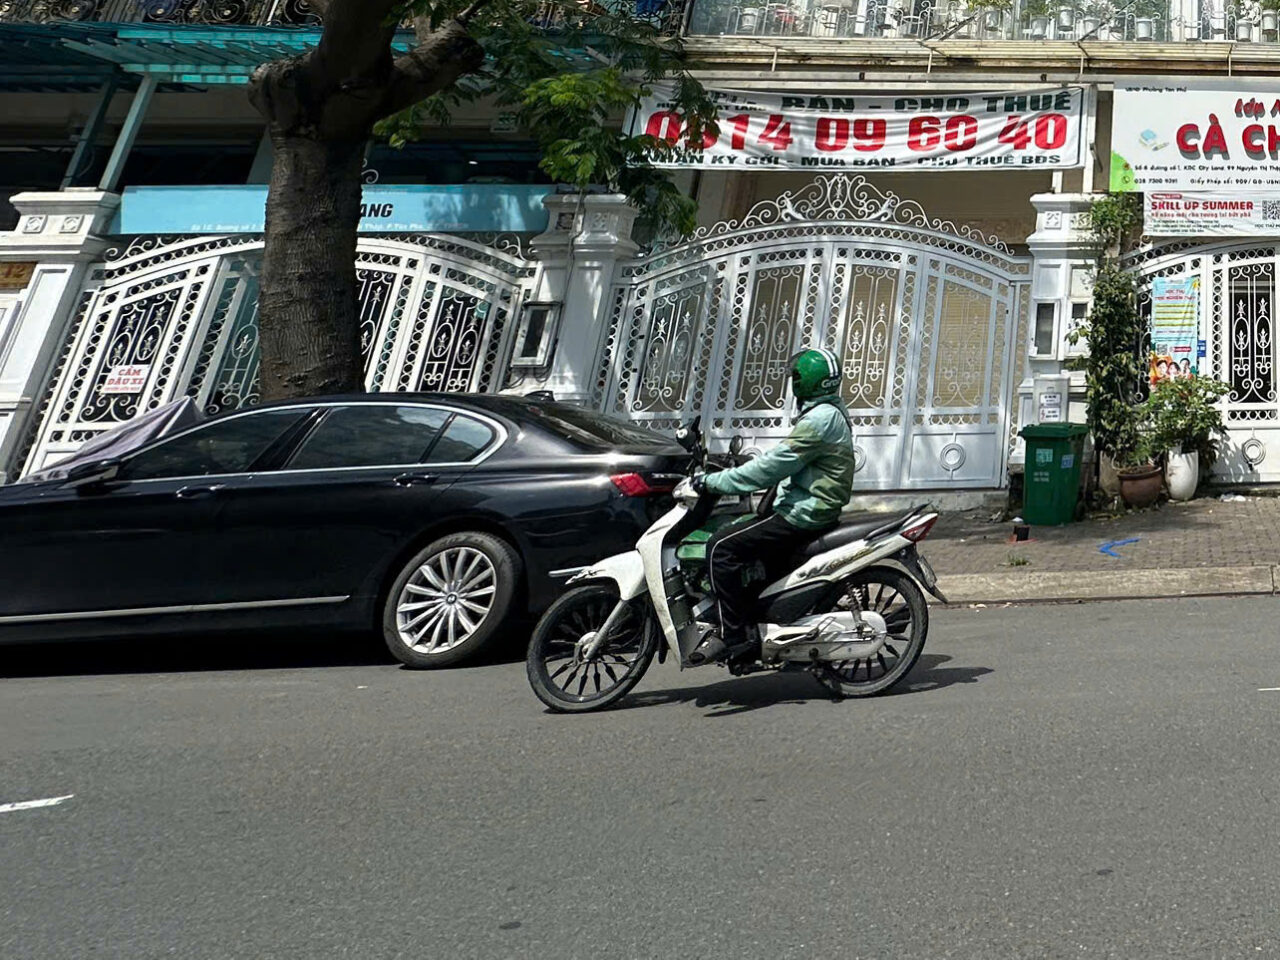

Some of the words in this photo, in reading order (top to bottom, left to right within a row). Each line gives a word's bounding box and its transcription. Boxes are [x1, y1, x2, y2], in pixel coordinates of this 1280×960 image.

[895, 97, 969, 113] CHO
[983, 91, 1071, 112] THUÊ
[815, 117, 887, 152] 09
[907, 115, 978, 152] 60
[997, 113, 1068, 151] 40
[1176, 113, 1230, 159] CÀ
[800, 156, 846, 166] MUA
[1151, 201, 1181, 210] SKILL
[1184, 201, 1199, 210] UP
[1202, 201, 1254, 210] SUMMER
